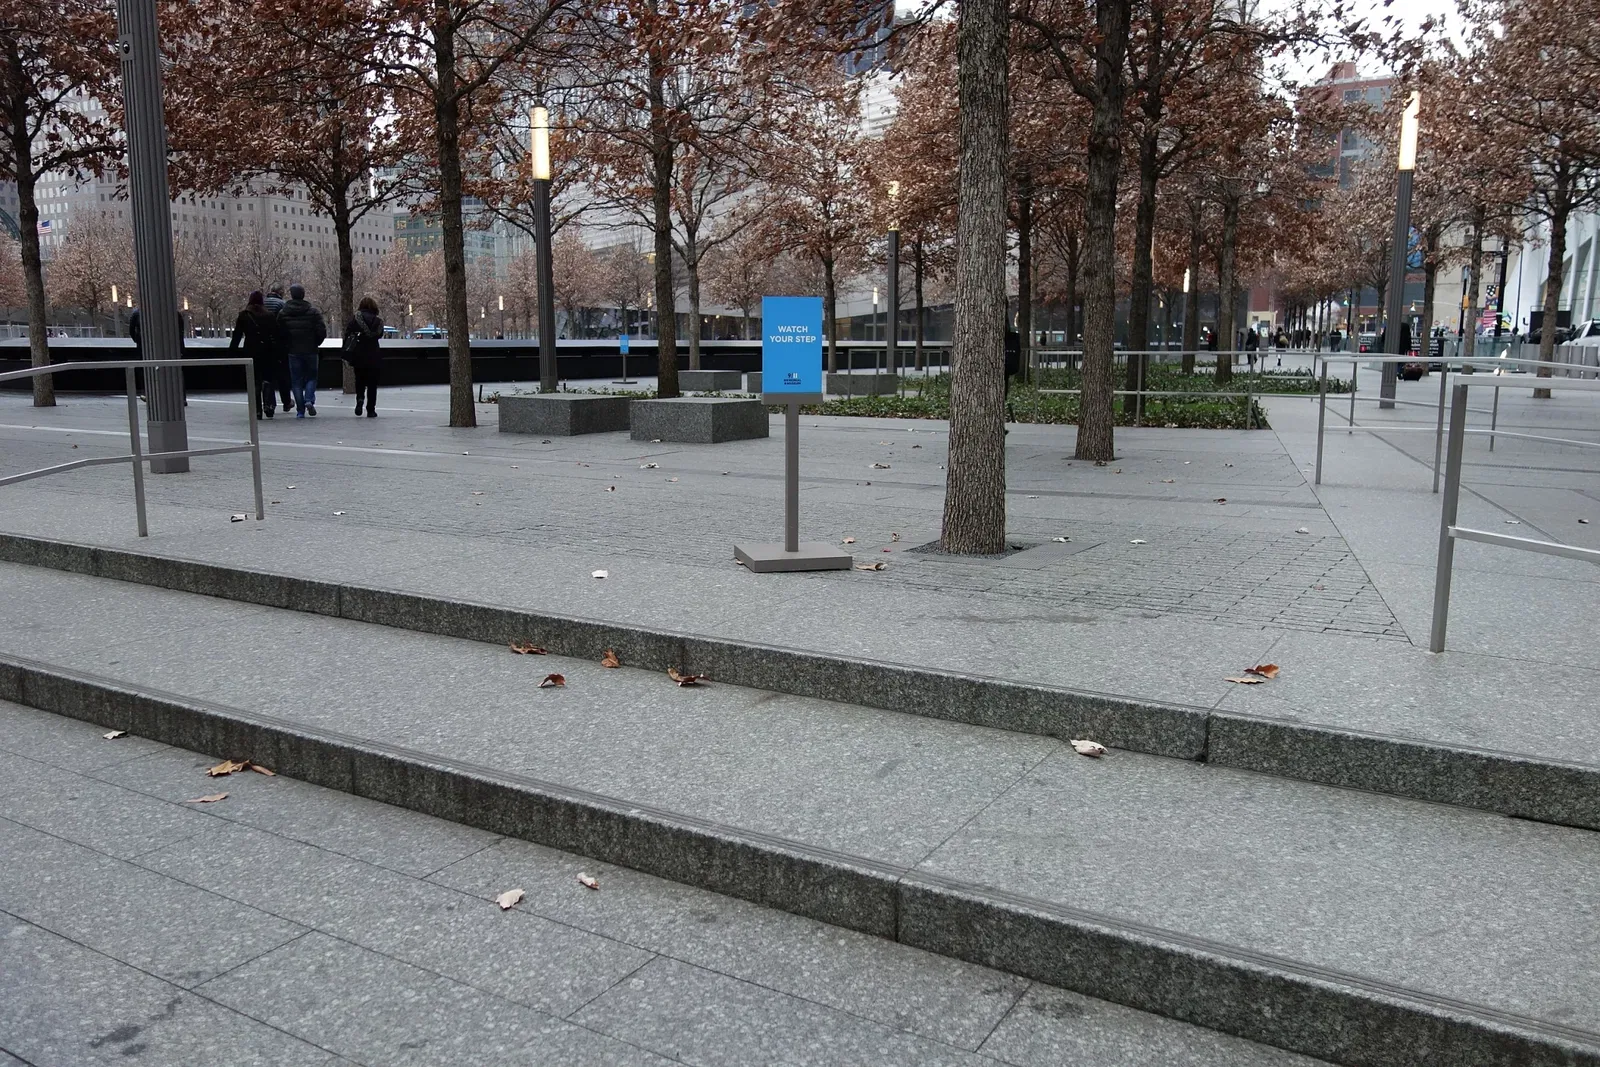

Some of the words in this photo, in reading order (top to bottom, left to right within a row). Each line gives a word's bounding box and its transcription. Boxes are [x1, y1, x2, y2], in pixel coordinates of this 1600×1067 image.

[777, 325, 808, 333] WATCH
[769, 335, 793, 343] YOUR
[795, 335, 817, 343] STEP
